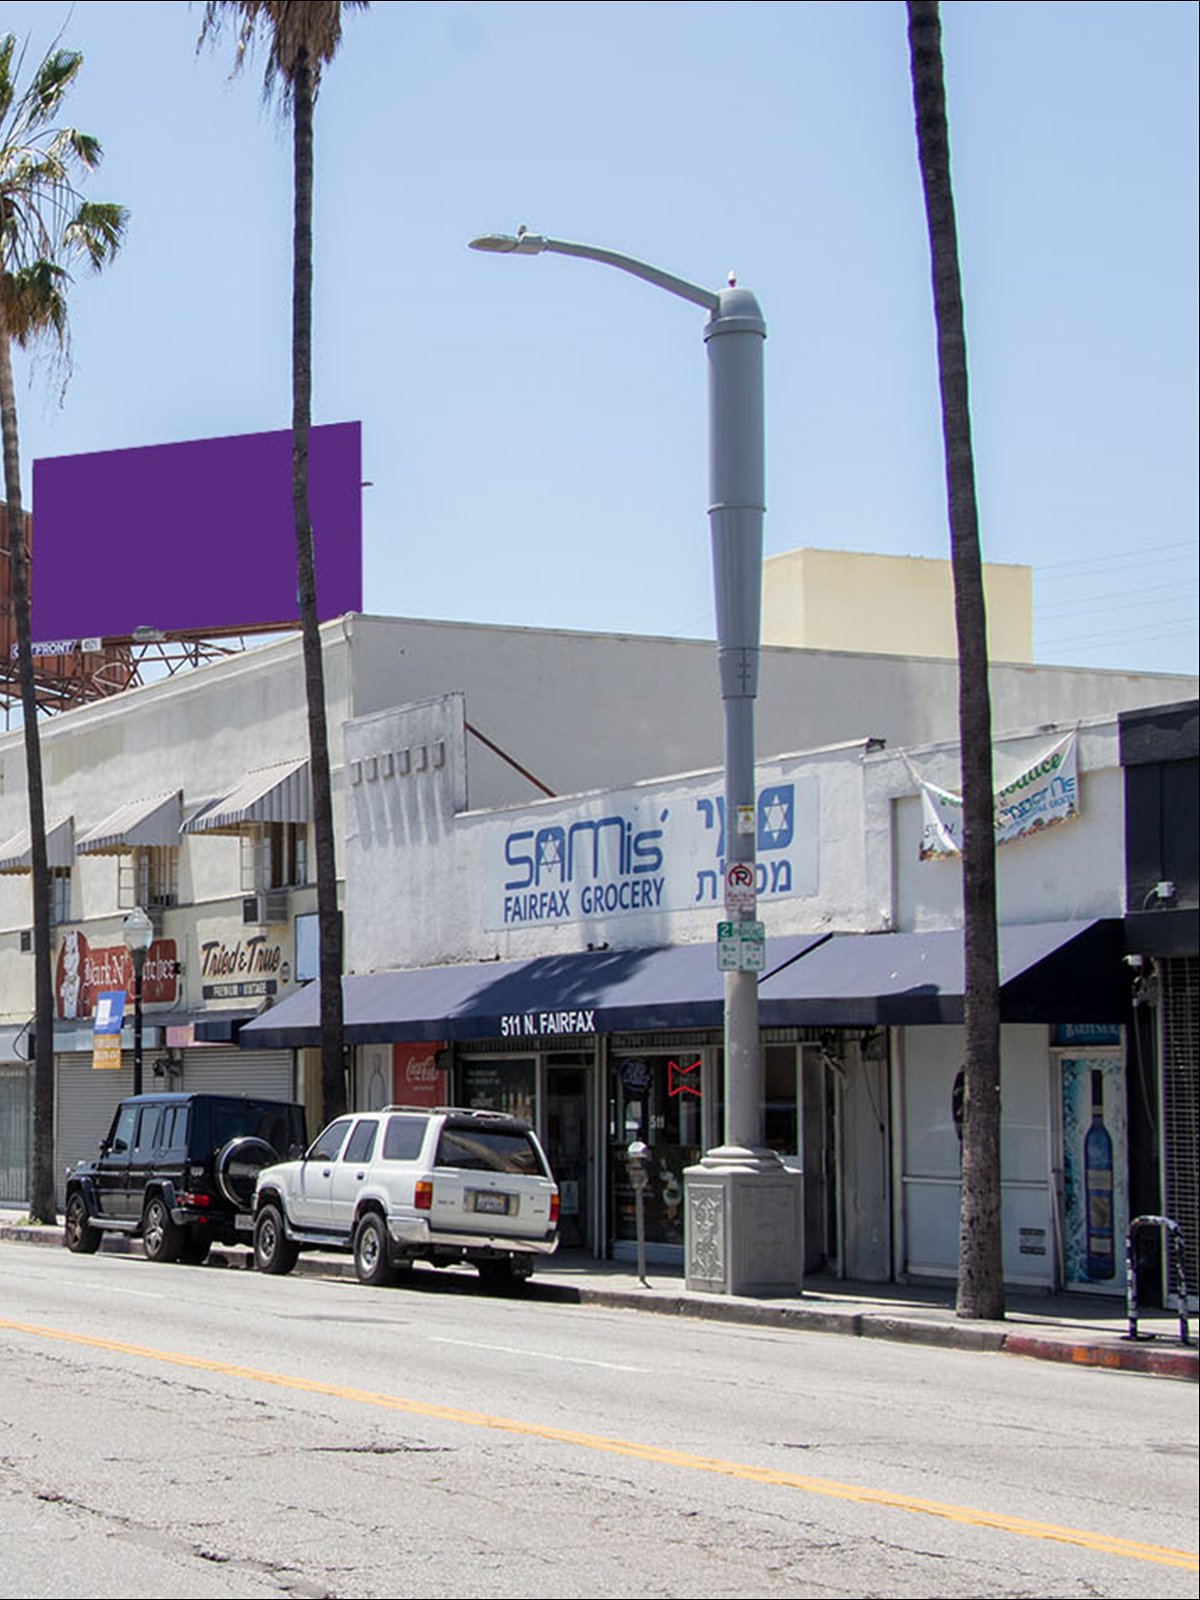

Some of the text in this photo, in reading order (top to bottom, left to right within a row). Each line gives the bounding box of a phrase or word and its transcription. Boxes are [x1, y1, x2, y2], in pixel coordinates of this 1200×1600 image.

[11, 640, 75, 658] OFRONT
[503, 877, 666, 923] FAIRFAX GROCERY
[202, 941, 241, 976] Tried
[246, 935, 281, 974] True
[500, 1010, 596, 1036] 511 N. FAIRFAX
